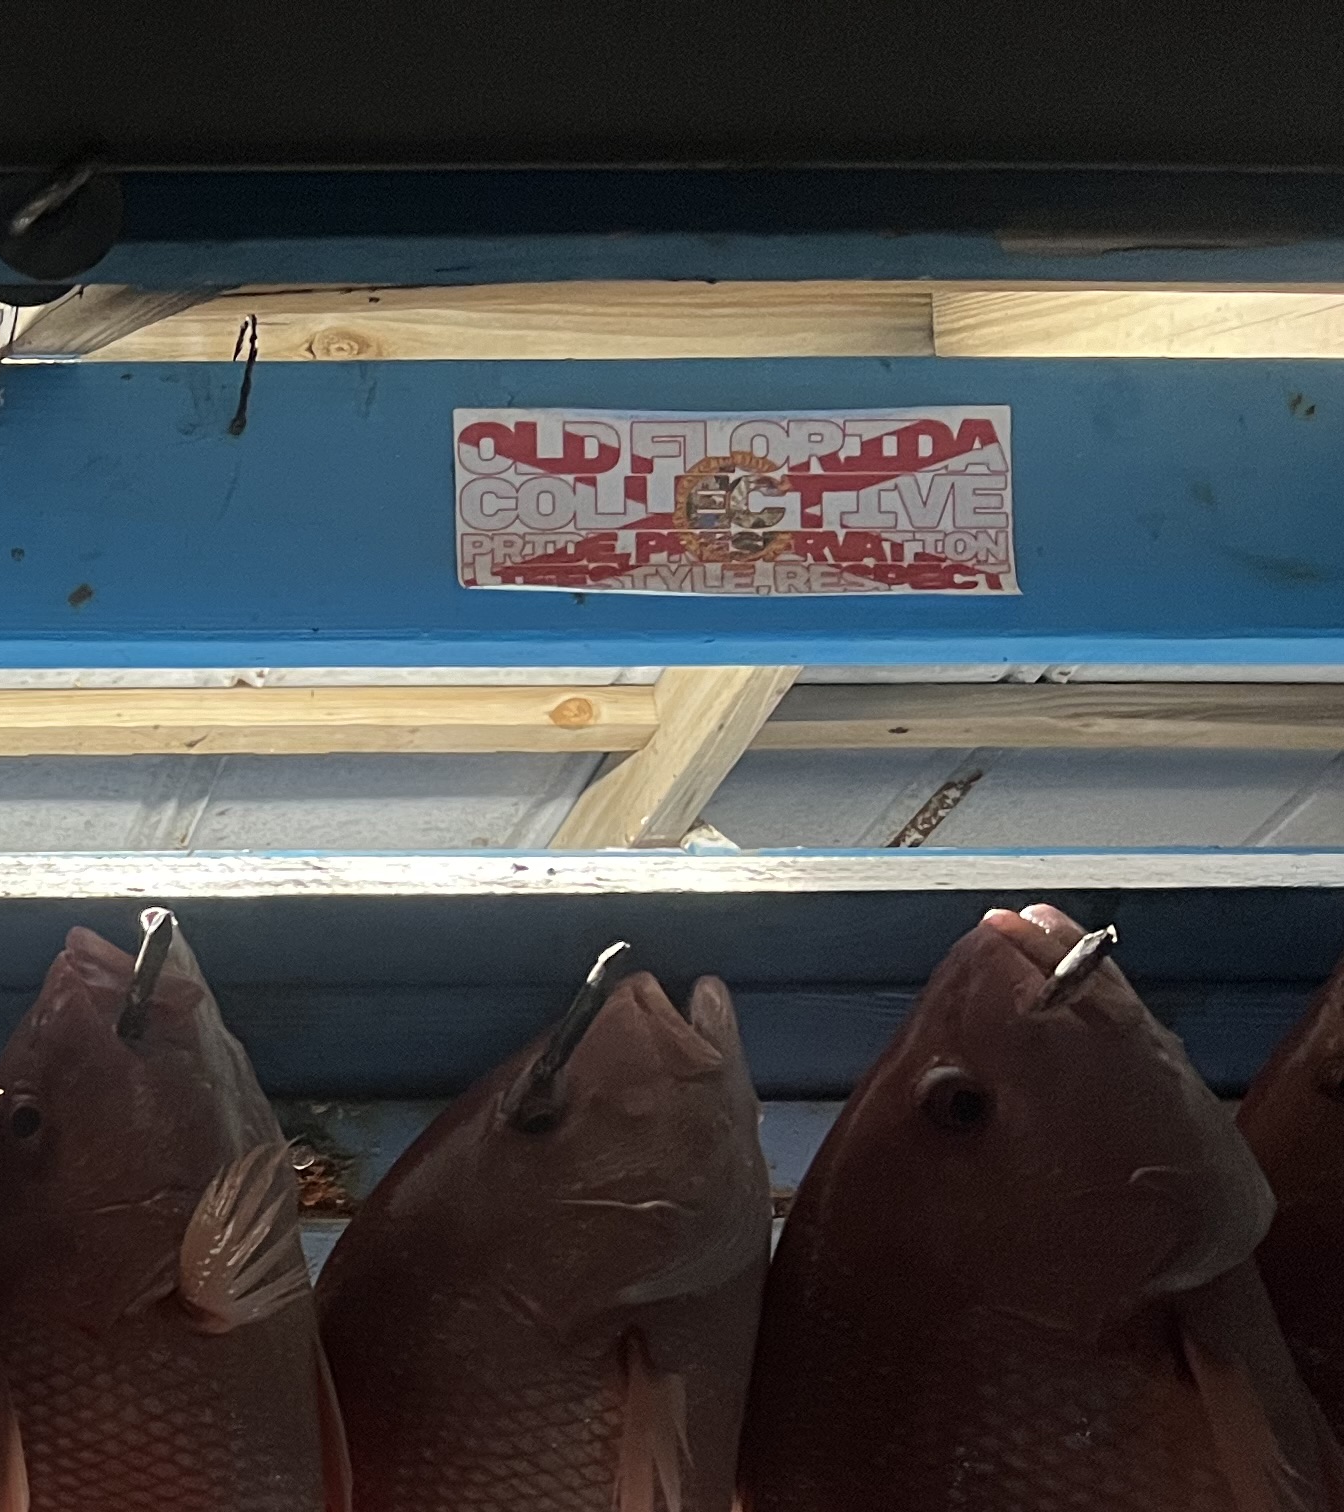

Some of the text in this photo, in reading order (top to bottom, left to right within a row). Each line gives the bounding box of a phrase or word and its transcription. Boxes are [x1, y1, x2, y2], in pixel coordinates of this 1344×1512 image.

[458, 418, 1009, 475] OLD FLORIDA
[460, 473, 1009, 531] COLLECTIVE
[635, 531, 1008, 564] PRESERVATION
[773, 562, 1011, 592] RESPECT
